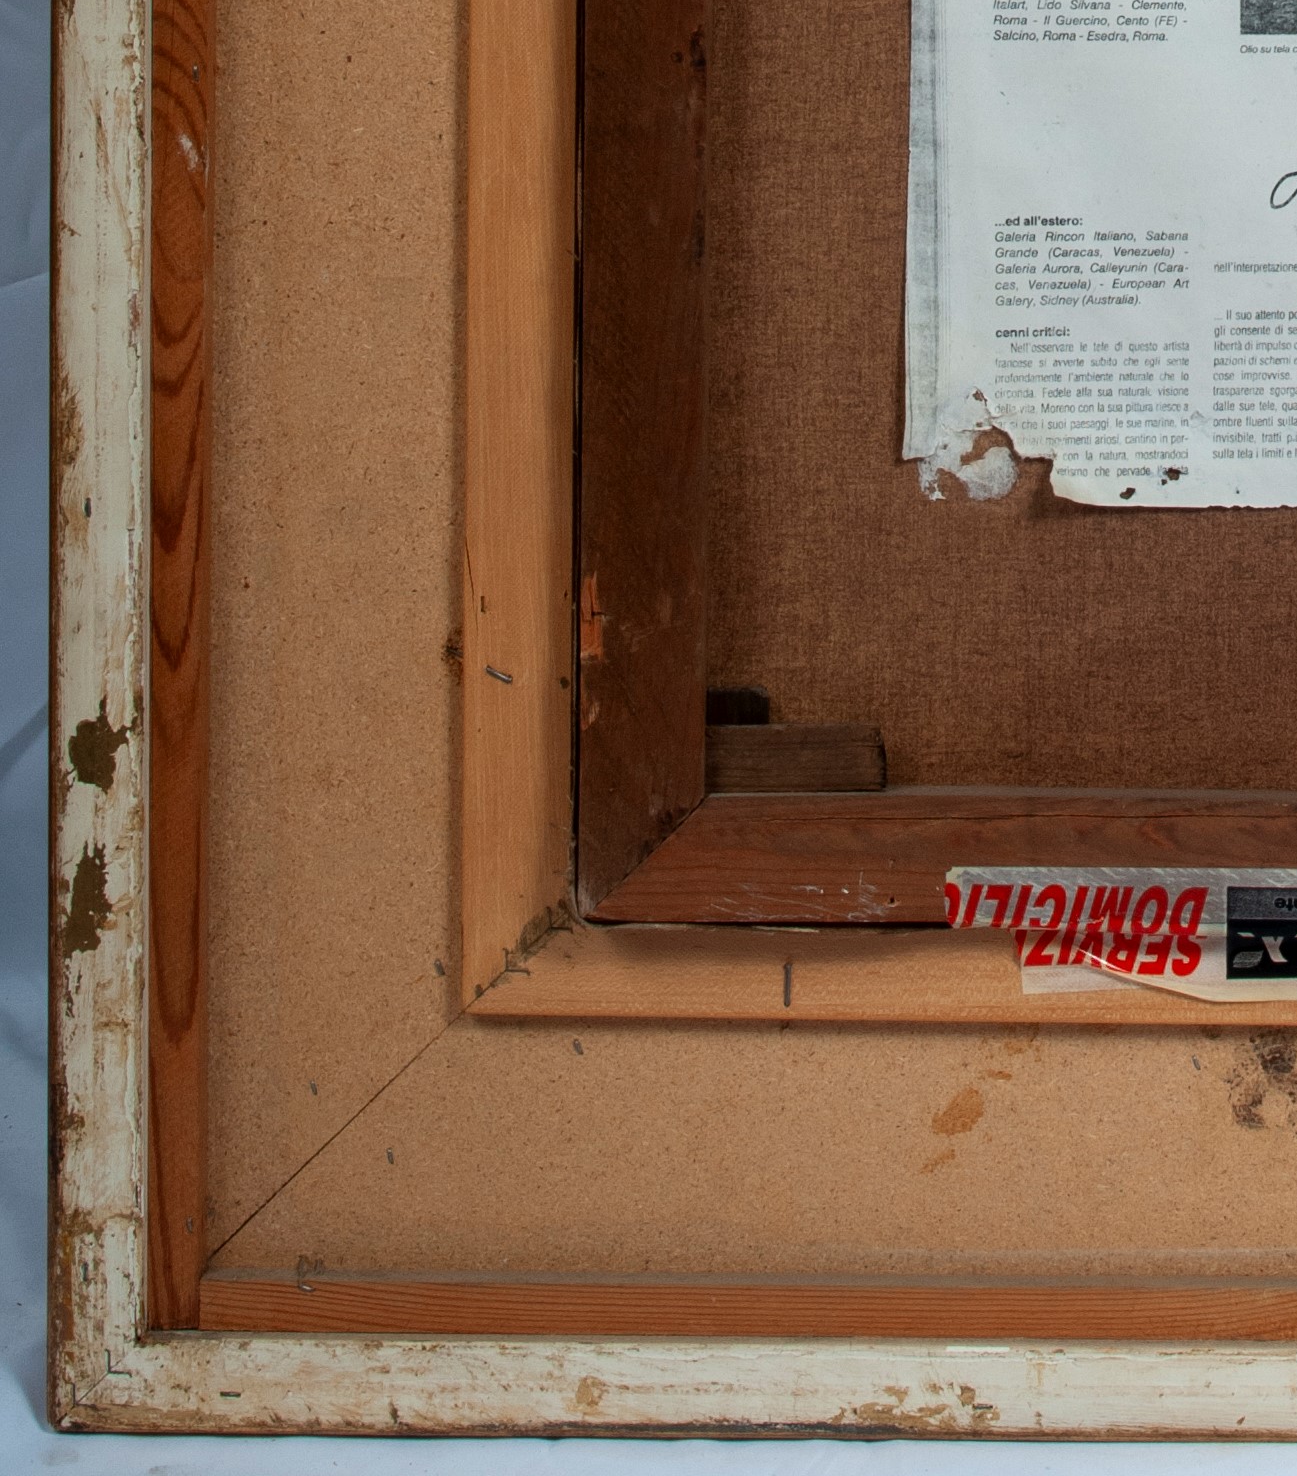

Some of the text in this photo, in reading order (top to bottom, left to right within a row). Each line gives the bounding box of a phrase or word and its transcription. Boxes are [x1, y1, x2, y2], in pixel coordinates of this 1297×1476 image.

[1036, 0, 1063, 11] Lido
[1069, 0, 1112, 11] Silvana
[1131, 0, 1187, 12] Clemente,
[993, 14, 1178, 28] Roma Il Guercino, Cento (FE)
[1042, 29, 1077, 42] Roma
[1086, 30, 1129, 44] Esedra,
[1239, 43, 1259, 54] Olio
[1260, 45, 1272, 54] su
[1273, 43, 1291, 54] tela
[1023, 215, 1083, 227] all'estero:
[994, 230, 1189, 243] Galeria Rincon Italiano, Sabana
[994, 246, 1176, 260] Grande (Caracas, Venezuela)
[995, 263, 1037, 275] Galeria
[1043, 263, 1083, 276] Aurora,
[1028, 278, 1092, 291] Venezuela)
[1111, 278, 1166, 291] European
[1172, 277, 1190, 289] Art
[1040, 294, 1078, 308] Sidney
[995, 326, 1070, 338] cenni critici:
